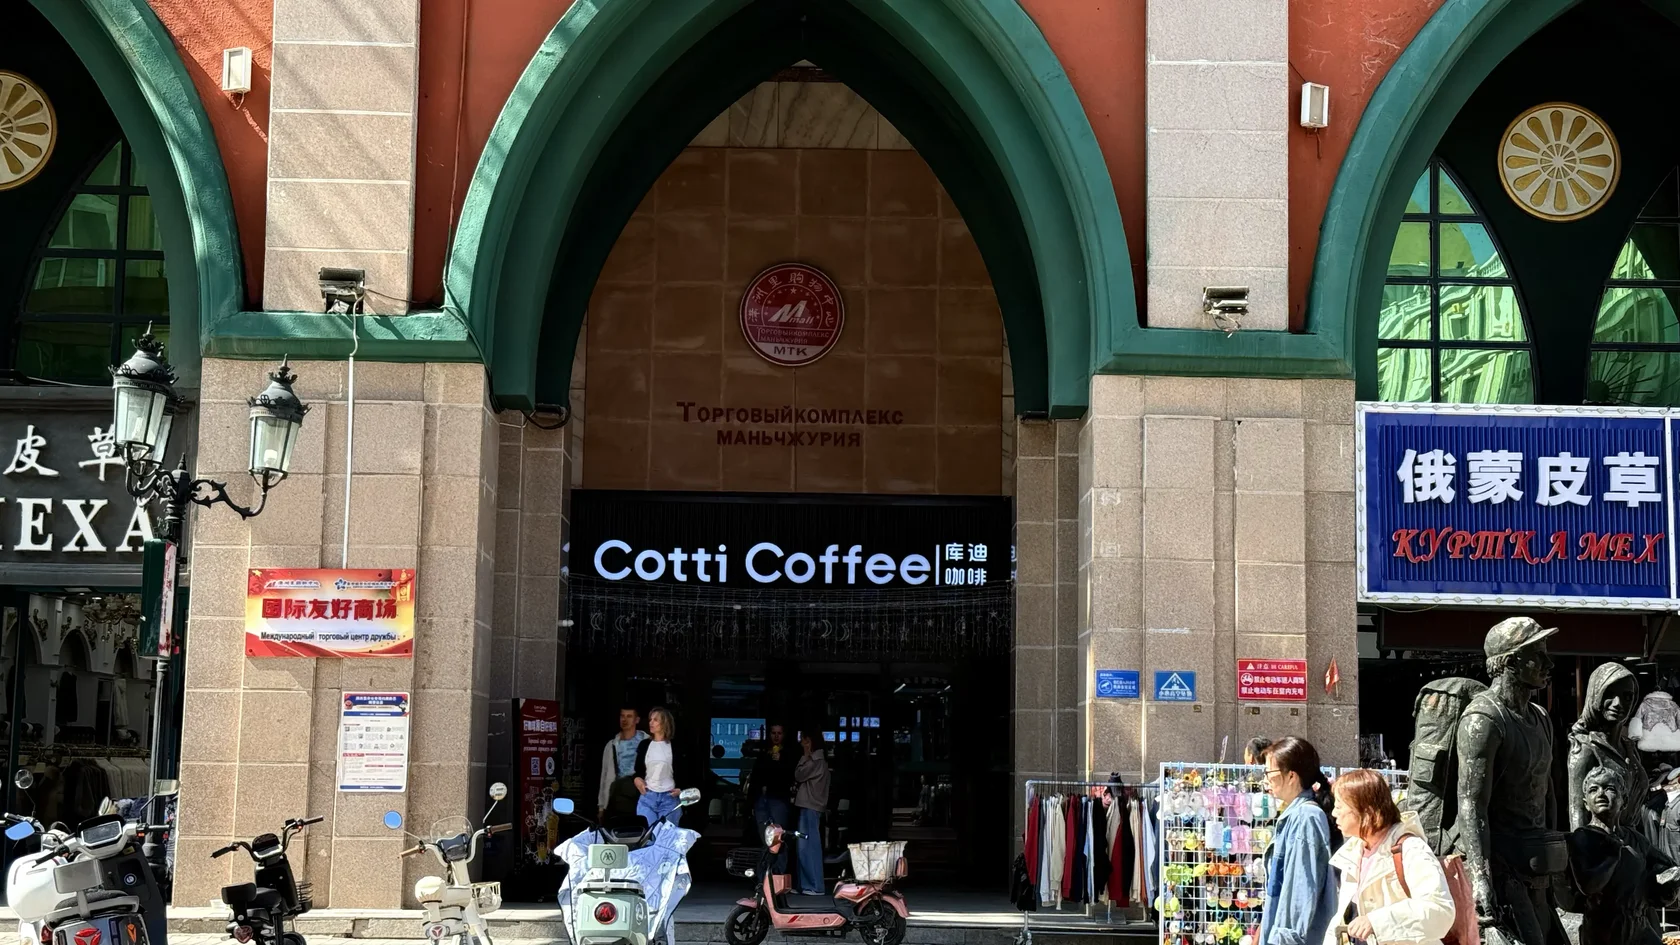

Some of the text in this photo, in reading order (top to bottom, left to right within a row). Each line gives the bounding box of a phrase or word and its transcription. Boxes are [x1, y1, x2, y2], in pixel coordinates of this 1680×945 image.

[716, 430, 861, 447] МАНЬЧЖУРИЯ
[3, 424, 126, 482] 皮草
[1397, 448, 1662, 508] 俄蒙皮草
[0, 497, 154, 552] ЕХА
[945, 543, 988, 562] 库迪
[1577, 532, 1665, 564] МЕХ
[594, 539, 931, 585] Cotti Coffee
[945, 568, 987, 586] 咖啡
[261, 598, 397, 621] 国际友好商场
[260, 631, 397, 642] Международный торговый центр дружбы
